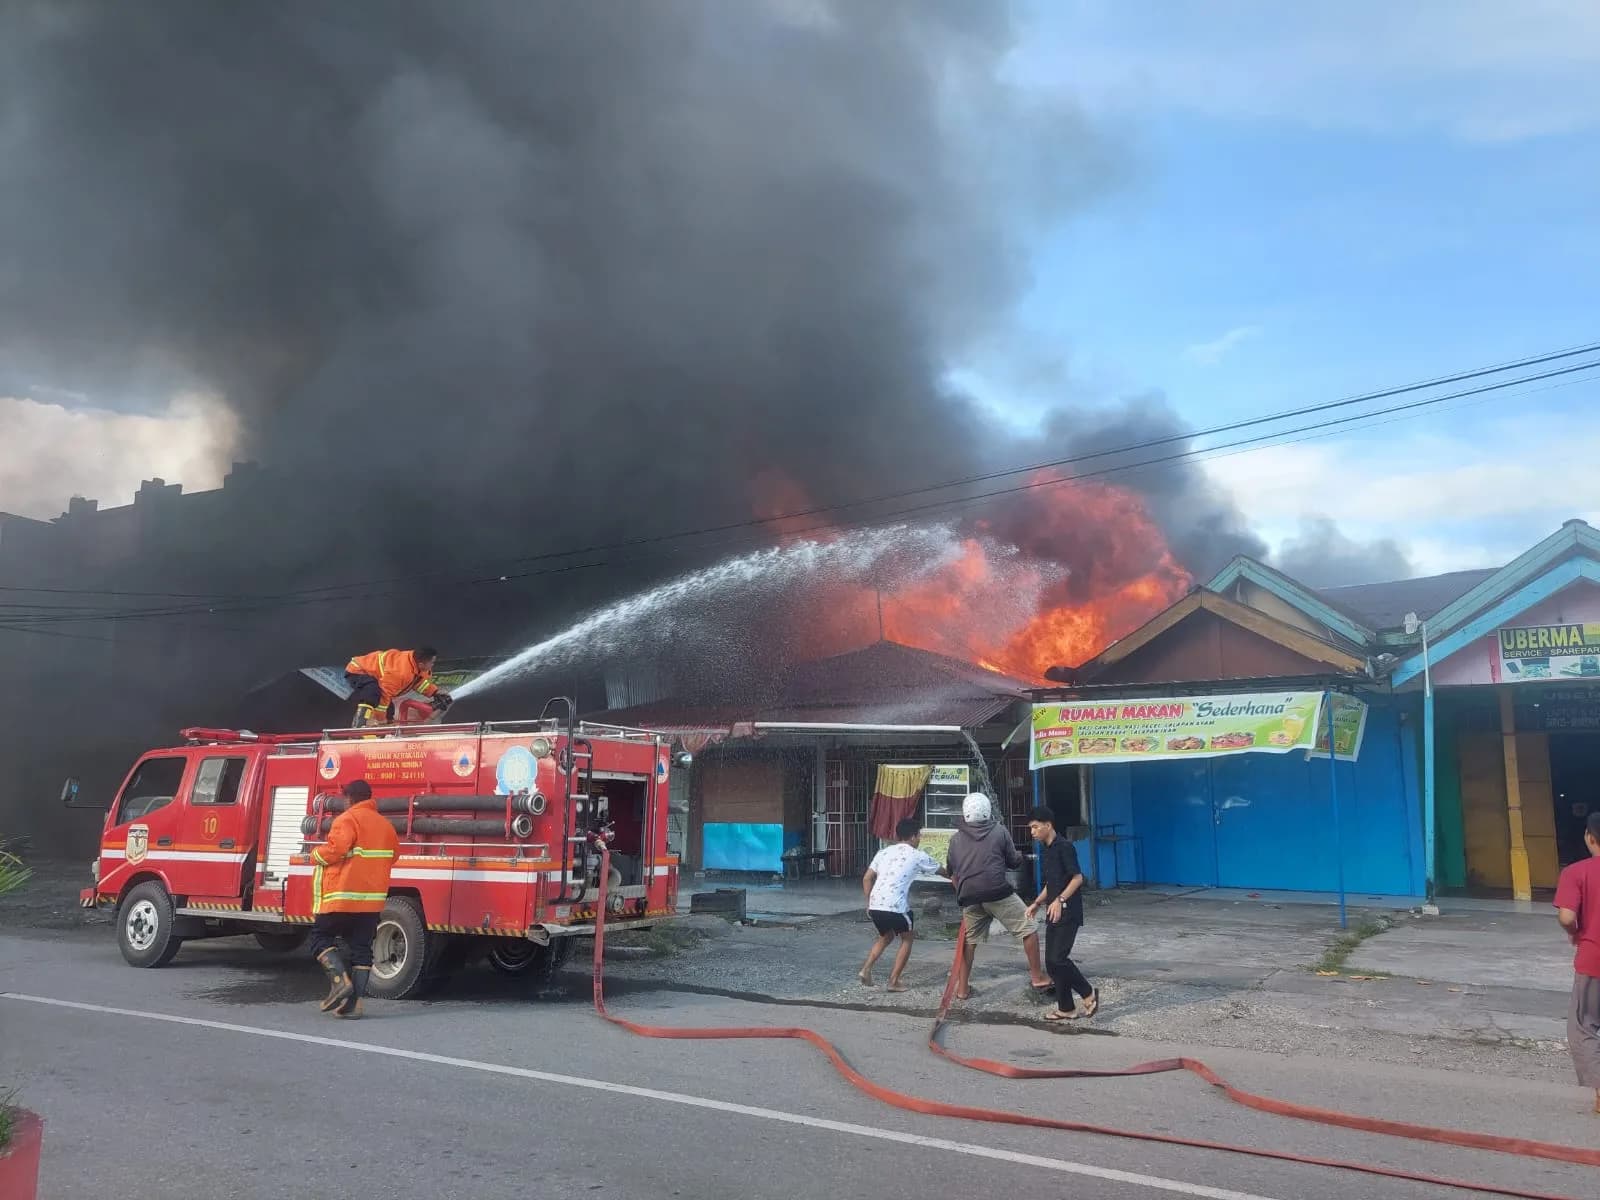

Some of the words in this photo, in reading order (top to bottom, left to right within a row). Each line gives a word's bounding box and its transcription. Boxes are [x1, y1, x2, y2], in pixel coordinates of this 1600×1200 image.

[1503, 626, 1583, 649] UBERMA
[1504, 649, 1542, 658] SERVICE
[1060, 707, 1118, 722] RUMAH
[1121, 703, 1183, 720] MAKAN
[1048, 729, 1067, 737] Menu
[204, 817, 217, 834] 10
